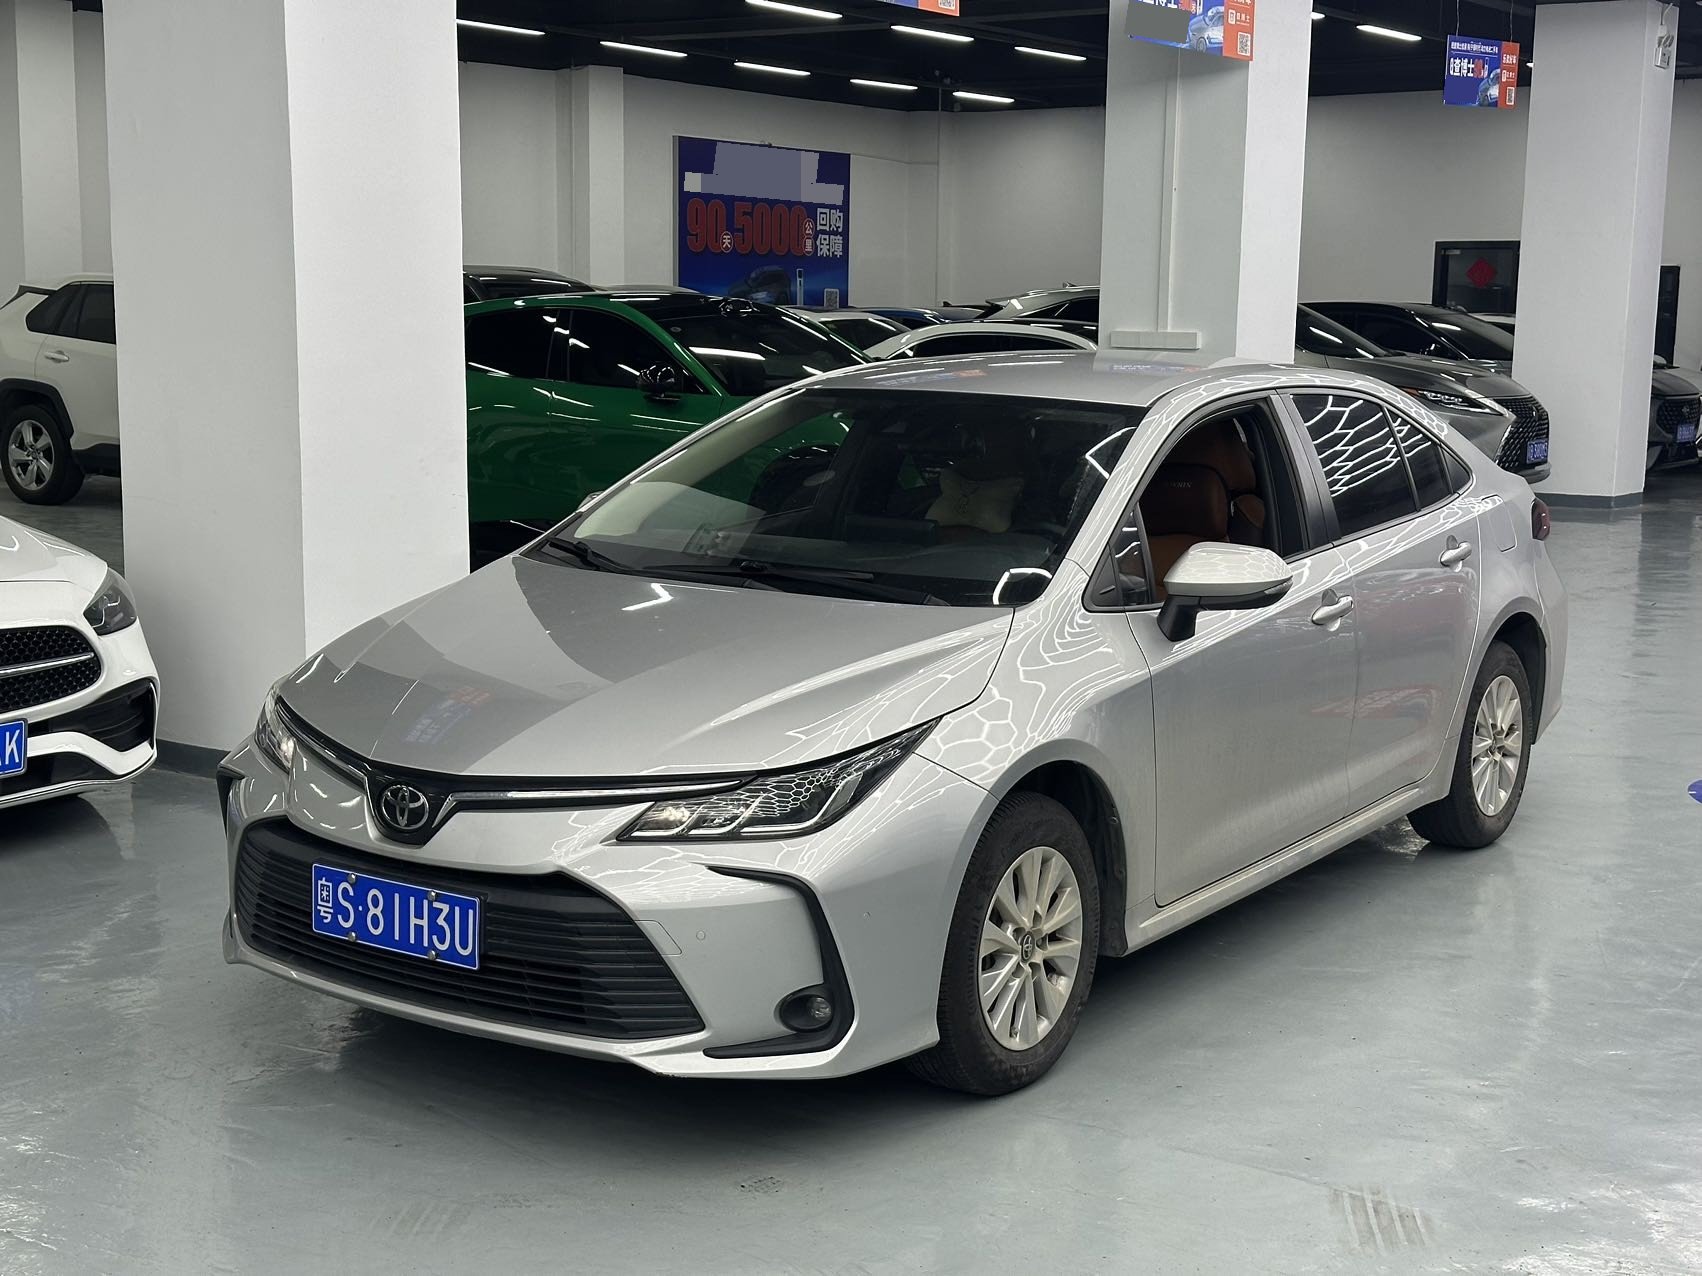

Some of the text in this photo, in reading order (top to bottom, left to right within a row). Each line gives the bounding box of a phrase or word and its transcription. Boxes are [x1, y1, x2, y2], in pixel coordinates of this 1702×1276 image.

[816, 207, 843, 232] 回购
[816, 234, 843, 258] 保障
[0, 729, 20, 766] K
